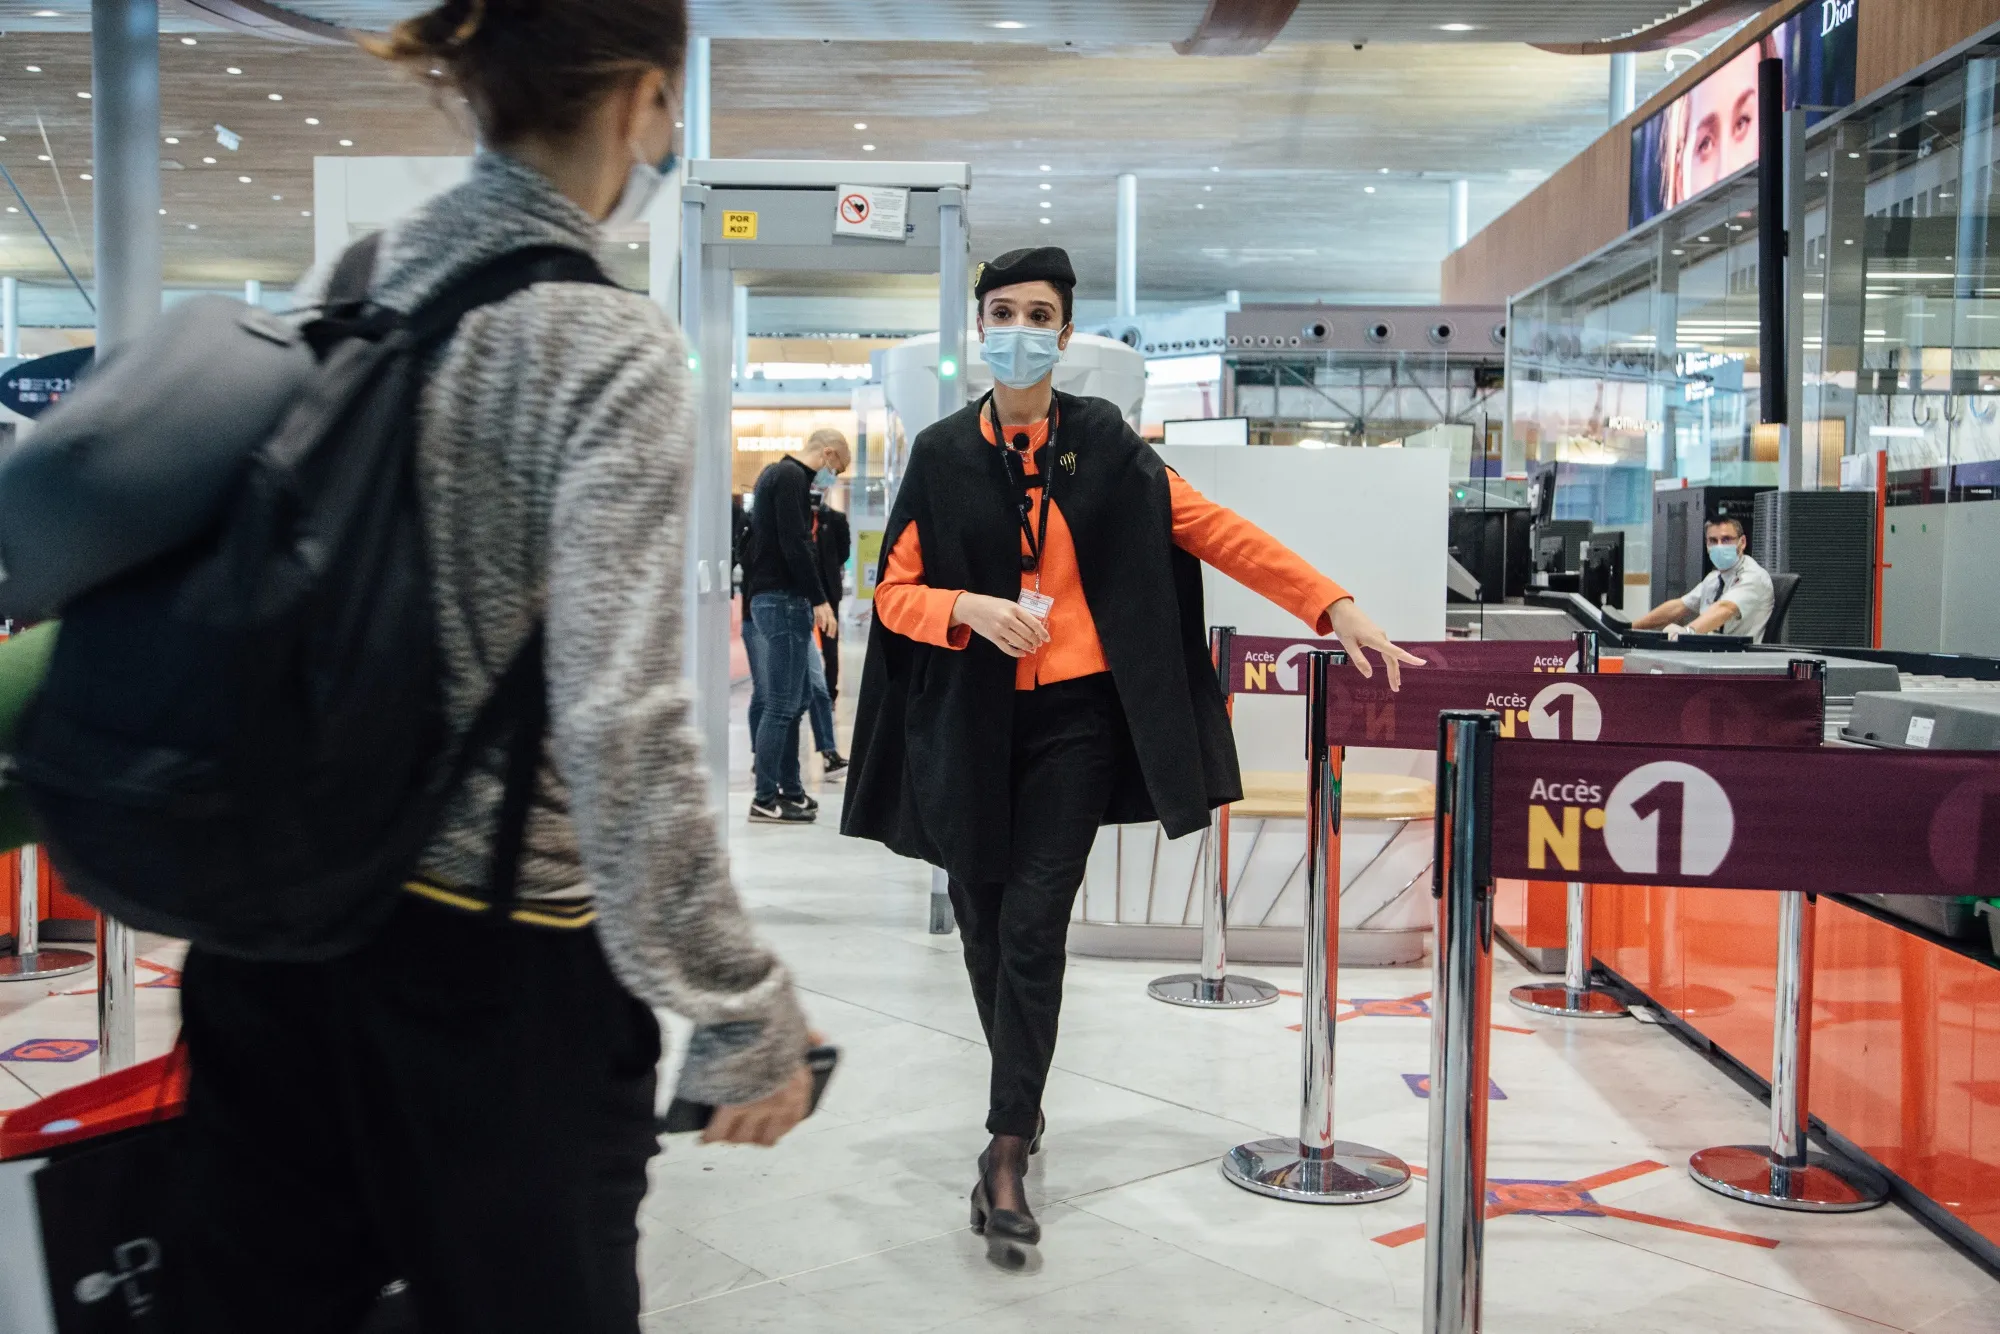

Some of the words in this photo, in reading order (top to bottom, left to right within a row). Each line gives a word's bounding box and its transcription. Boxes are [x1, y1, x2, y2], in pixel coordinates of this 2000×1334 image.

[1820, 0, 1855, 37] Dior
[1245, 651, 1275, 662] Accès
[1534, 655, 1564, 666] Accès
[1486, 692, 1527, 708] Accès
[1529, 778, 1602, 803] Accès
